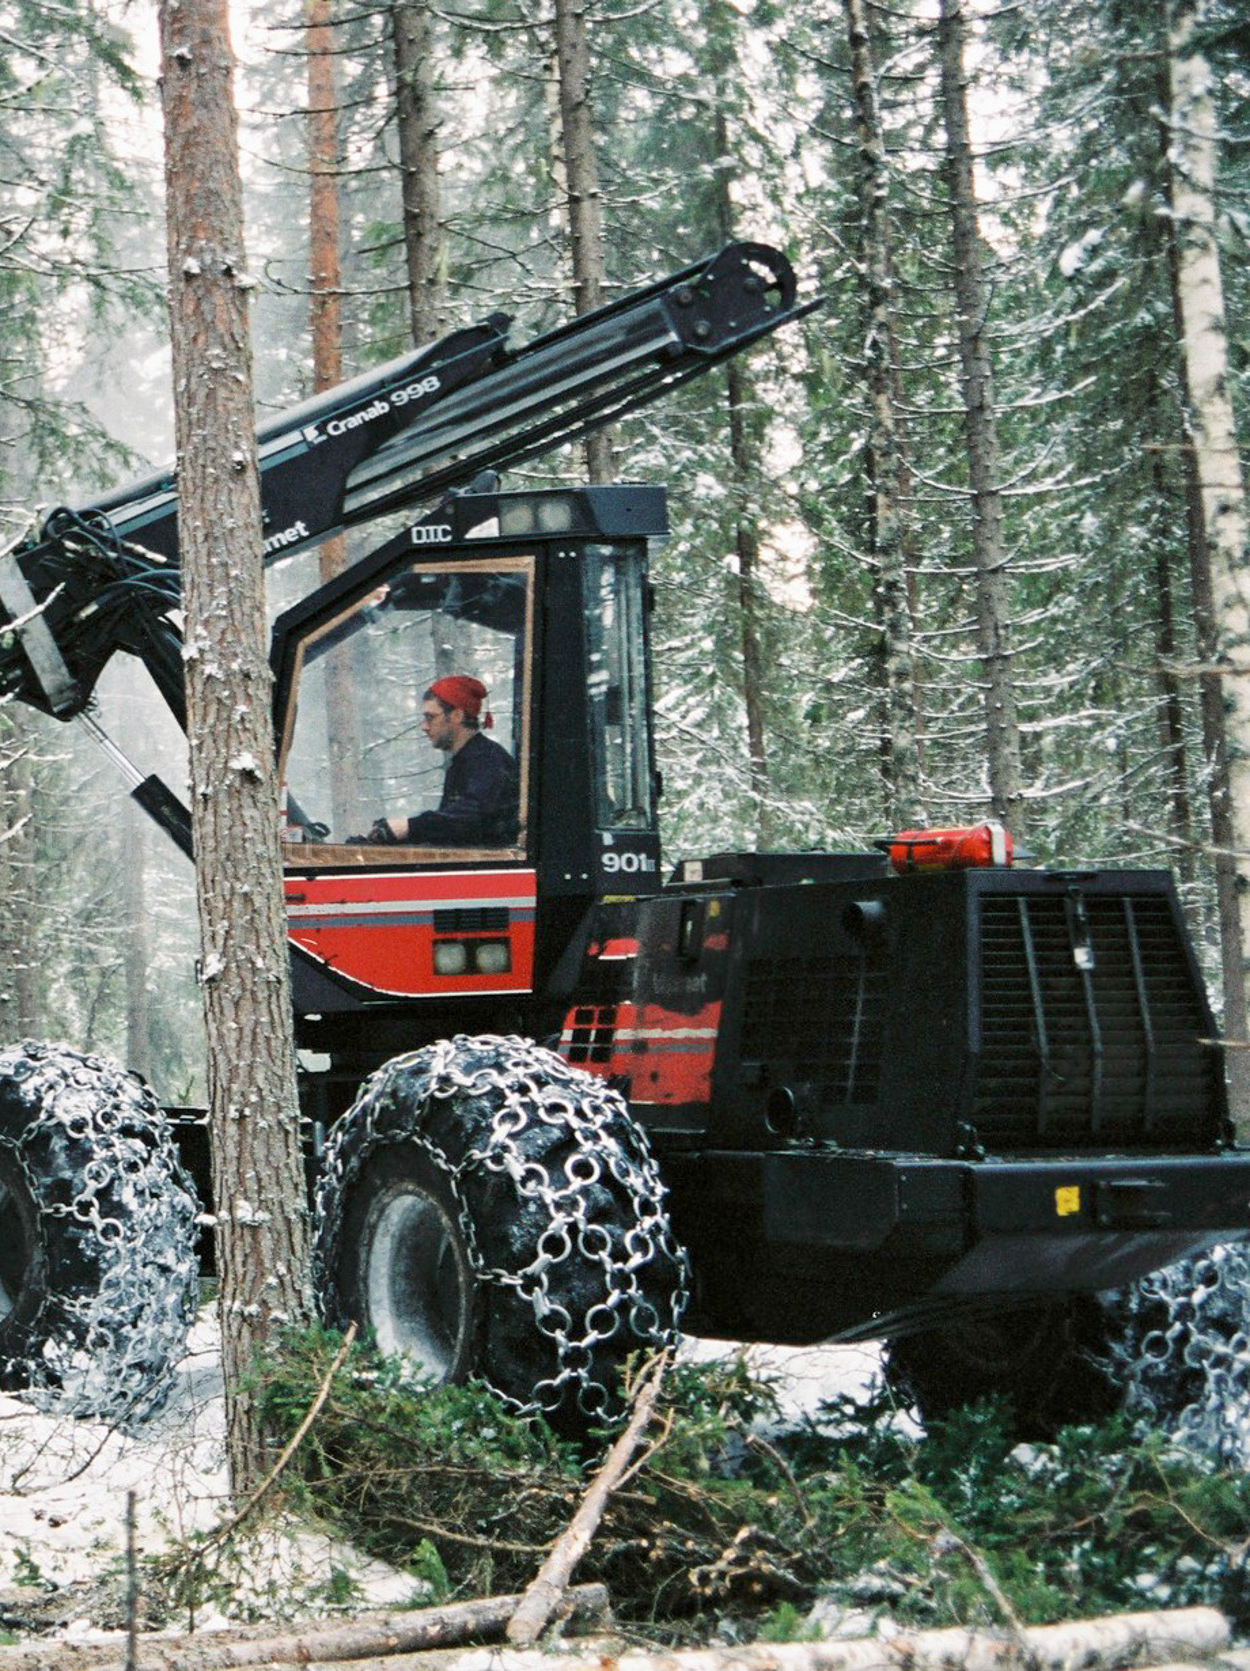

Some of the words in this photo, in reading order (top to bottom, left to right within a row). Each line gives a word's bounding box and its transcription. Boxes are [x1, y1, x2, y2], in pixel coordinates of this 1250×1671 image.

[326, 399, 391, 436] Cranab
[390, 375, 442, 407] 998
[263, 520, 310, 553] met
